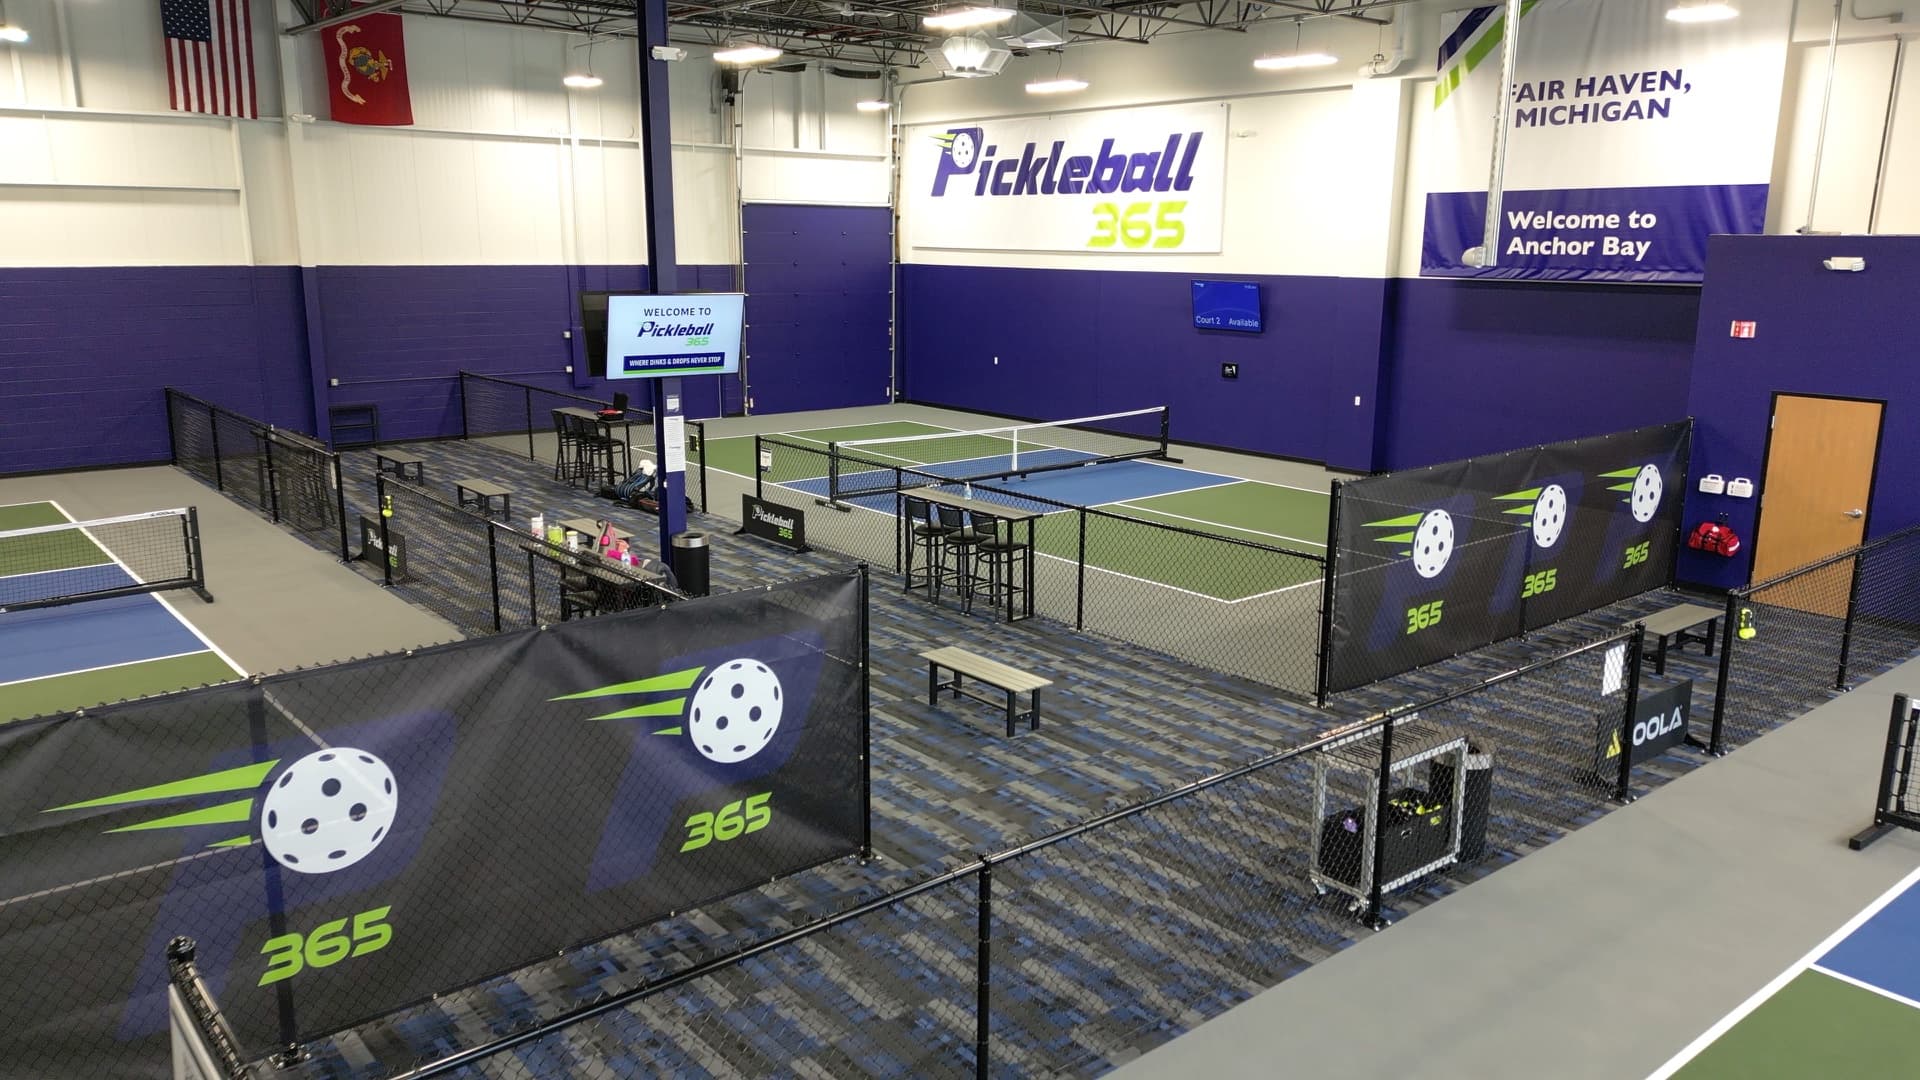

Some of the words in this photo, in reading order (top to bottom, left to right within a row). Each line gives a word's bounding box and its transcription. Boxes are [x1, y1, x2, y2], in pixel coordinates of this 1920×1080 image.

[1574, 69, 1691, 98] HAVEN,
[1515, 97, 1671, 128] MICHIGAN
[930, 126, 1204, 197] Pickleball
[1086, 201, 1188, 249] 365
[1507, 211, 1620, 230] Welcome
[1628, 210, 1657, 229] to
[1506, 236, 1595, 256] Anchor
[1602, 236, 1652, 262] Bay
[643, 307, 696, 317] WELCOME
[698, 307, 712, 316] TO
[1195, 315, 1214, 325] Court
[1216, 316, 1221, 325] 2
[1228, 317, 1259, 328] Available
[637, 321, 714, 337] Pickleball
[685, 336, 710, 346] 365
[629, 359, 649, 367] WHERE
[650, 358, 666, 366] DINKS
[672, 357, 690, 365] DROPS
[691, 356, 707, 365] NEVER
[708, 355, 721, 364] STOP
[752, 504, 795, 530] Pickleball
[777, 527, 793, 540] 365
[1624, 541, 1651, 569] 365
[1522, 568, 1557, 598] 365
[1406, 600, 1443, 635] 365
[1632, 706, 1683, 746] OOLA
[680, 792, 772, 852] 365
[258, 905, 393, 987] 365
